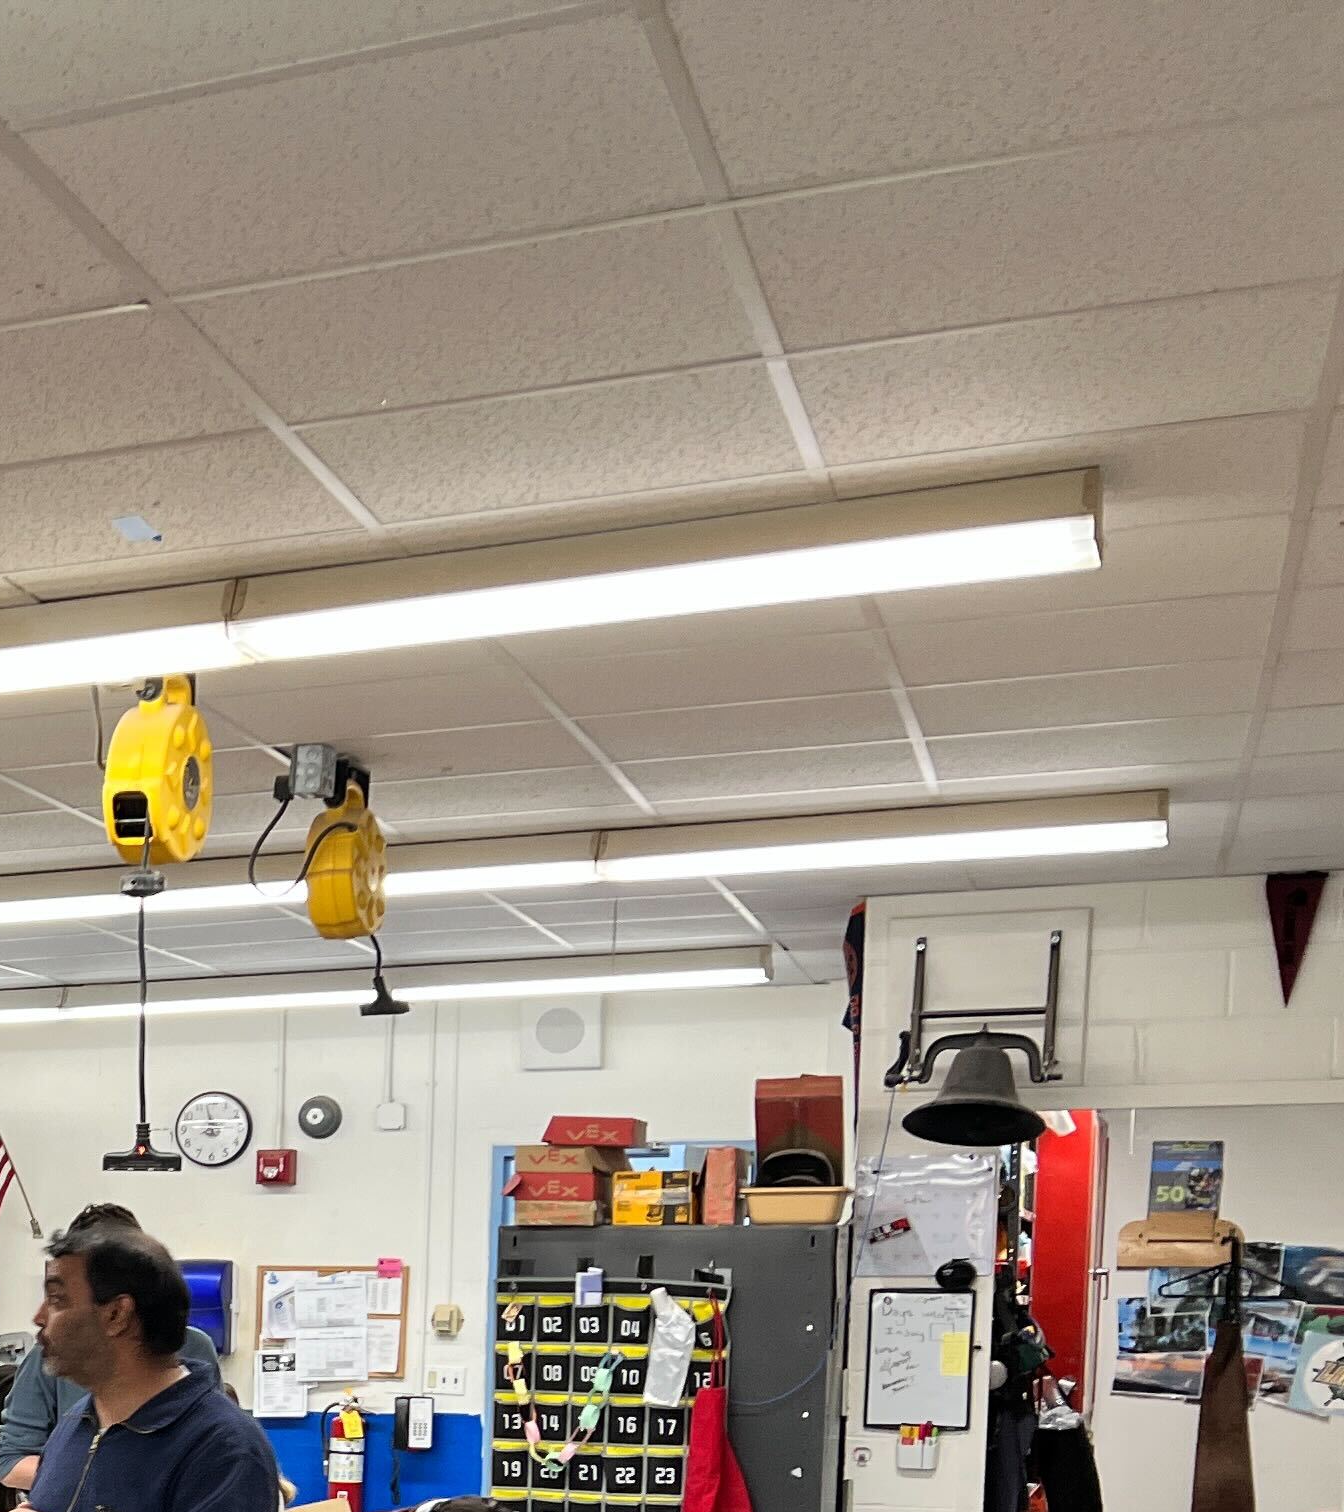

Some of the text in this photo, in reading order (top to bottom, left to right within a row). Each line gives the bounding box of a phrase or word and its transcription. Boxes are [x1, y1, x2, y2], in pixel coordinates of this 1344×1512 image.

[566, 1123, 619, 1142] VEX
[208, 1152, 215, 1161] 6
[528, 1149, 577, 1166] VEX
[528, 1180, 579, 1198] VEX
[542, 1316, 563, 1333] 02
[579, 1317, 600, 1334] 03
[620, 1320, 641, 1338] 04
[699, 1332, 712, 1347] 6
[542, 1365, 562, 1381] 08
[621, 1369, 640, 1386] 10
[693, 1372, 712, 1389] 12
[502, 1413, 522, 1430] 13
[541, 1414, 560, 1431] 14
[617, 1416, 637, 1434] 16
[657, 1418, 677, 1435] 17
[502, 1460, 522, 1478] 19
[578, 1464, 598, 1481] 21
[615, 1467, 636, 1484] 22
[654, 1467, 676, 1485] 23
